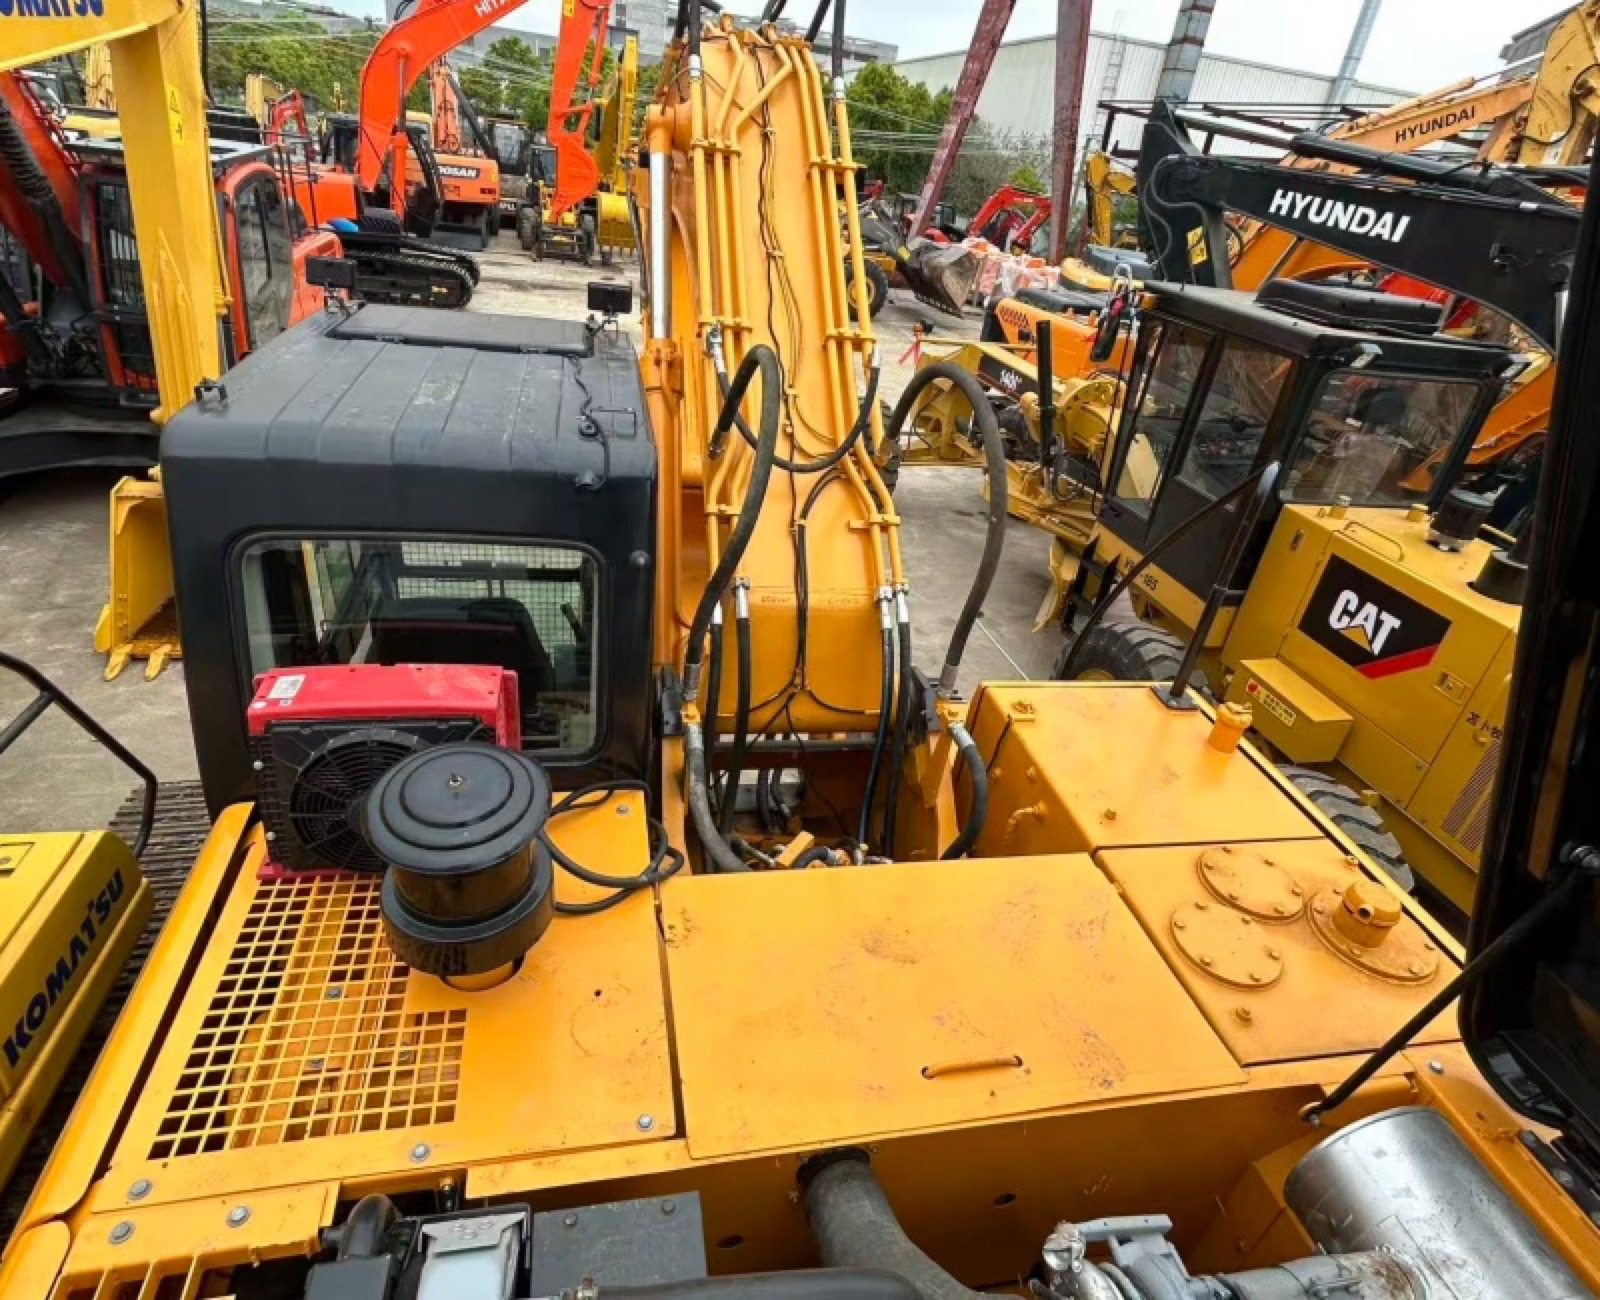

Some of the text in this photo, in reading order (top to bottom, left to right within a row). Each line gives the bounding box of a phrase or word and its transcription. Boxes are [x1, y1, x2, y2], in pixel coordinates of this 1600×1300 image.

[1395, 105, 1475, 144] HYUNDAI
[1268, 188, 1411, 242] HYUNDAI
[1328, 589, 1402, 656] CAT
[3, 867, 125, 1069] KOMATSU
